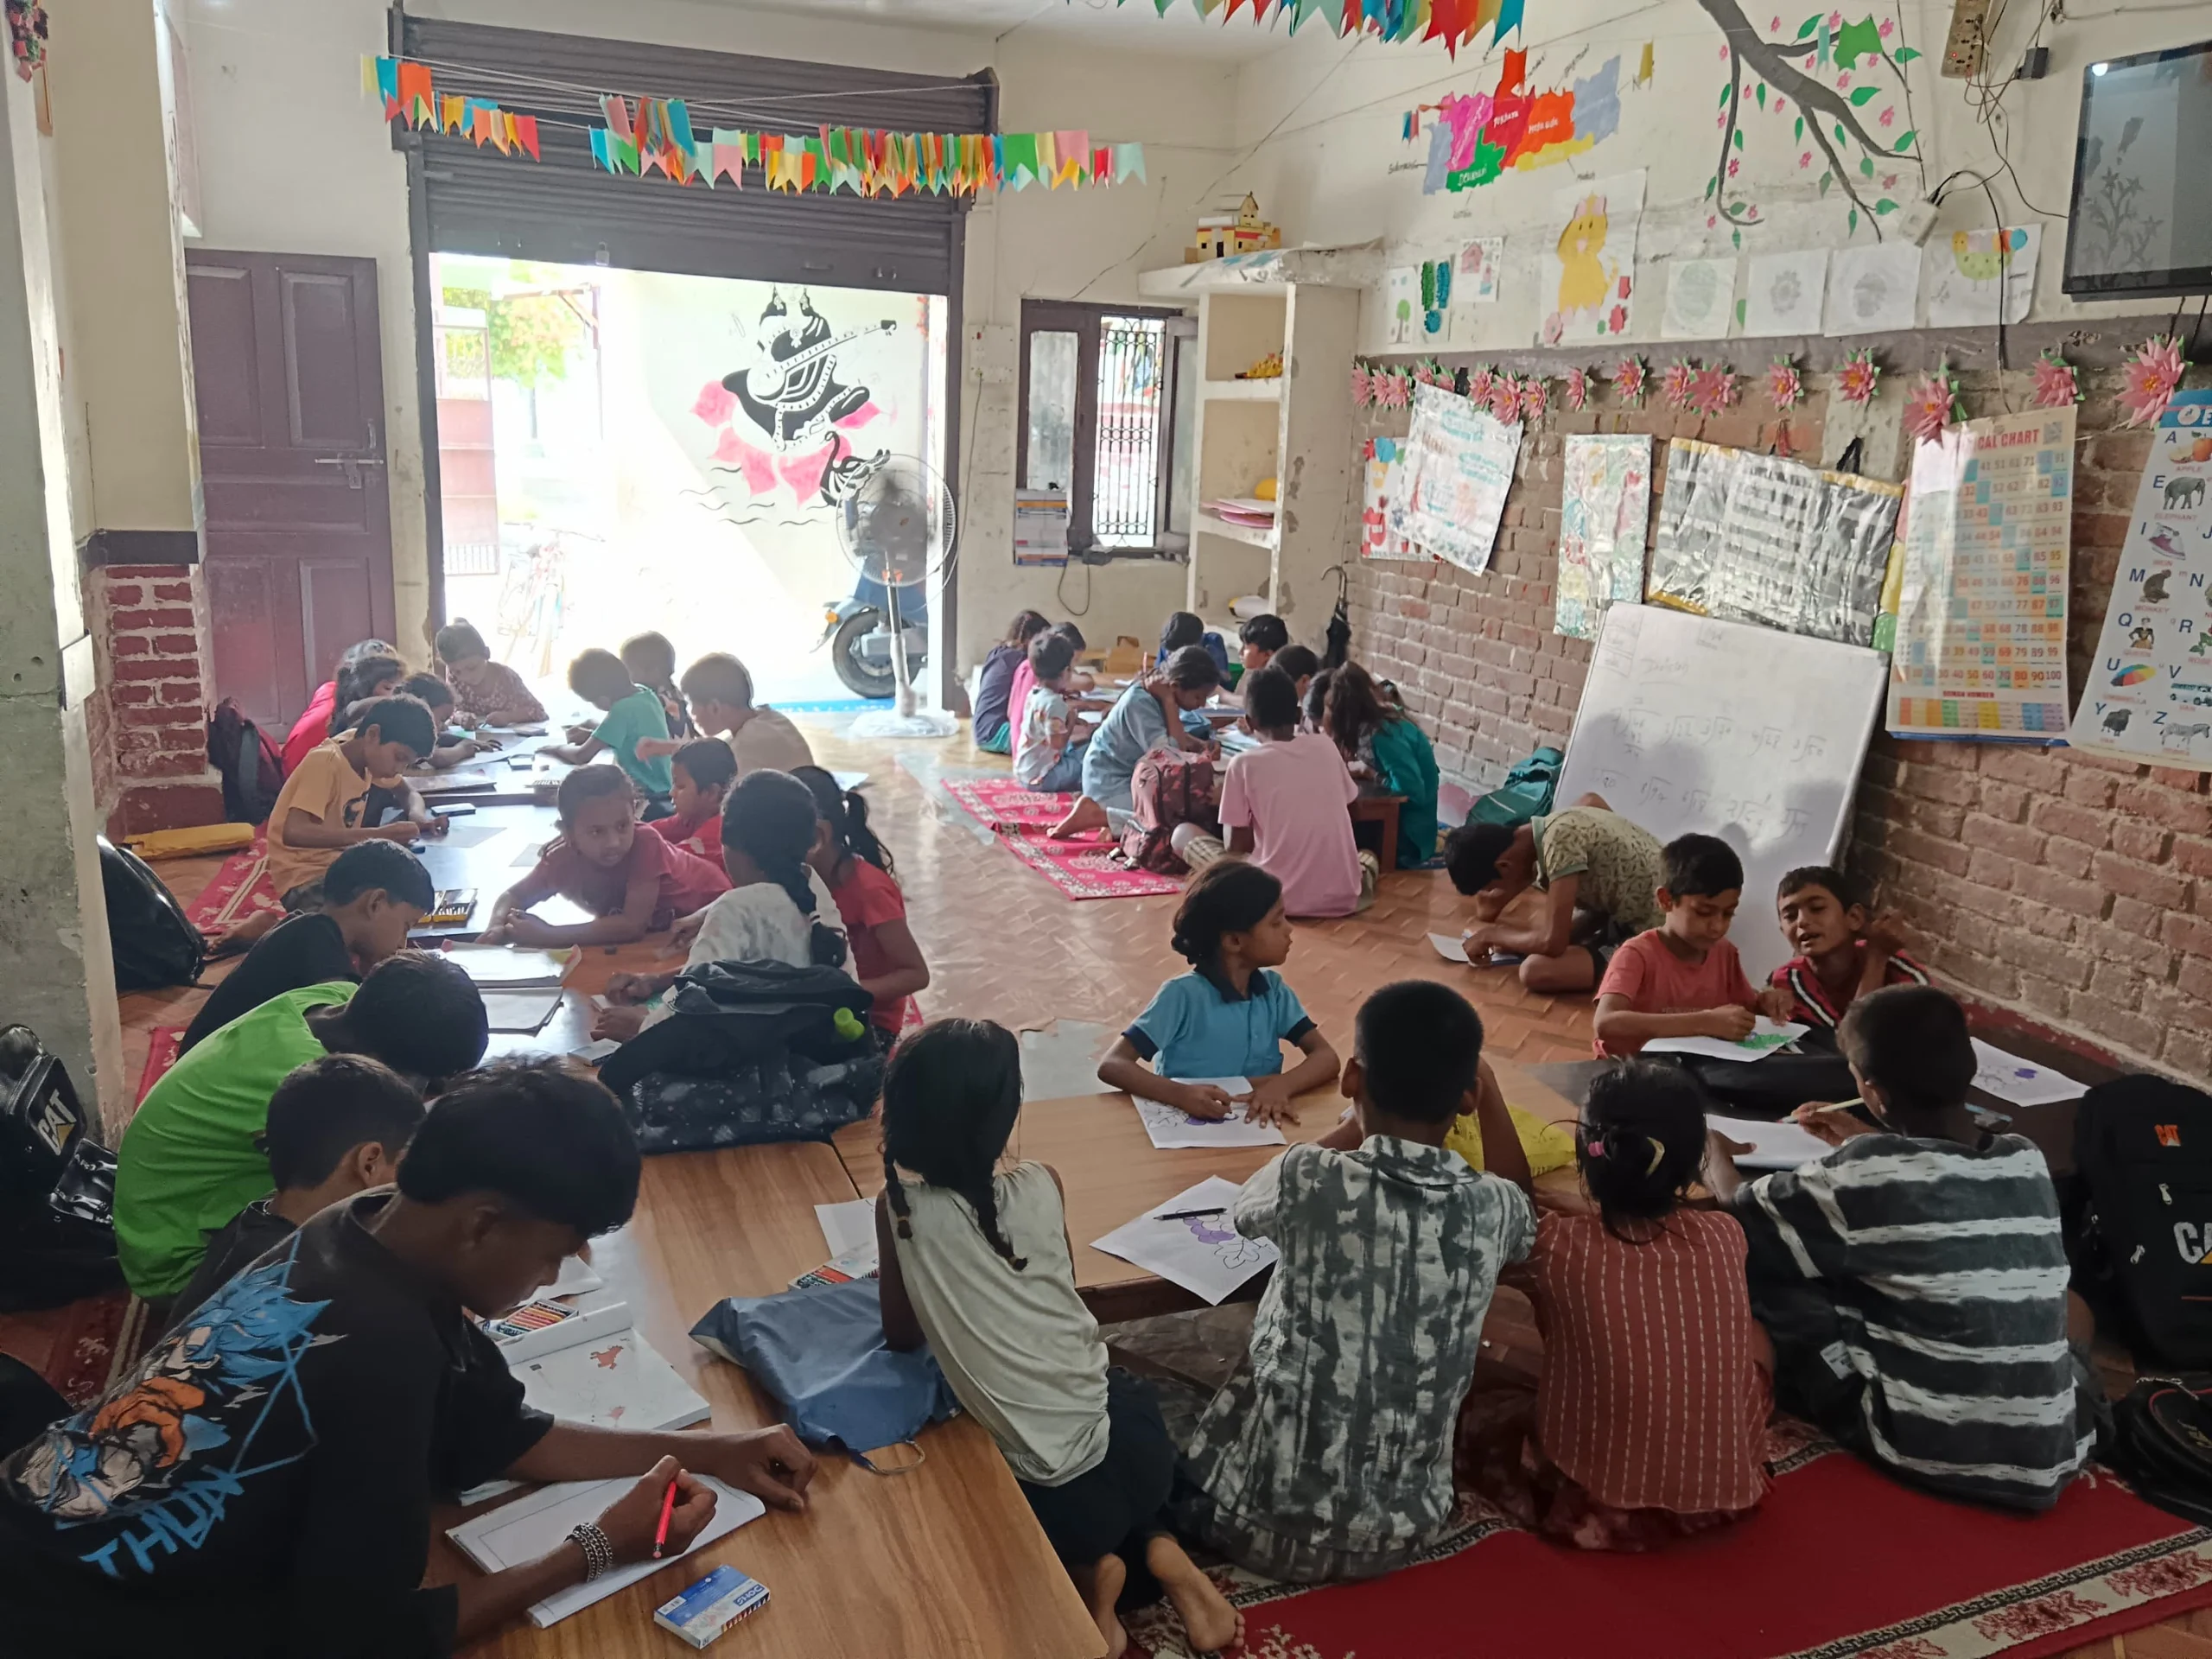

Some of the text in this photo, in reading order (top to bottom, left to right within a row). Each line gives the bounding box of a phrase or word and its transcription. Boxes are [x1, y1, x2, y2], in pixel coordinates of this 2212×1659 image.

[2001, 429, 2039, 448] CHART
[2164, 430, 2177, 443] A
[2024, 455, 2035, 467] 71
[2152, 474, 2166, 489] E
[2052, 501, 2063, 512] 93
[2154, 513, 2197, 522] ELEPHANT
[2140, 522, 2146, 535] I
[2050, 550, 2062, 560] 95
[2129, 568, 2145, 582] M
[2189, 573, 2204, 588] N
[2016, 599, 2028, 609] 77
[2031, 599, 2045, 609] 87
[2015, 624, 2027, 633] 78
[2118, 613, 2133, 627] Q
[2178, 619, 2193, 633] R
[2015, 647, 2027, 657] 79
[2031, 647, 2044, 657] 89
[2048, 646, 2058, 657] 99
[2107, 657, 2120, 671] U
[2169, 664, 2182, 679] V
[1982, 670, 1994, 680] 60
[2015, 671, 2028, 680] 80
[2031, 671, 2044, 681] 90
[2045, 671, 2062, 680] 100
[2095, 702, 2107, 715] Y
[2152, 710, 2168, 725] Z
[37, 1087, 78, 1156] CAT
[2153, 1124, 2182, 1147] CAT
[737, 1585, 763, 1605] DOMS
